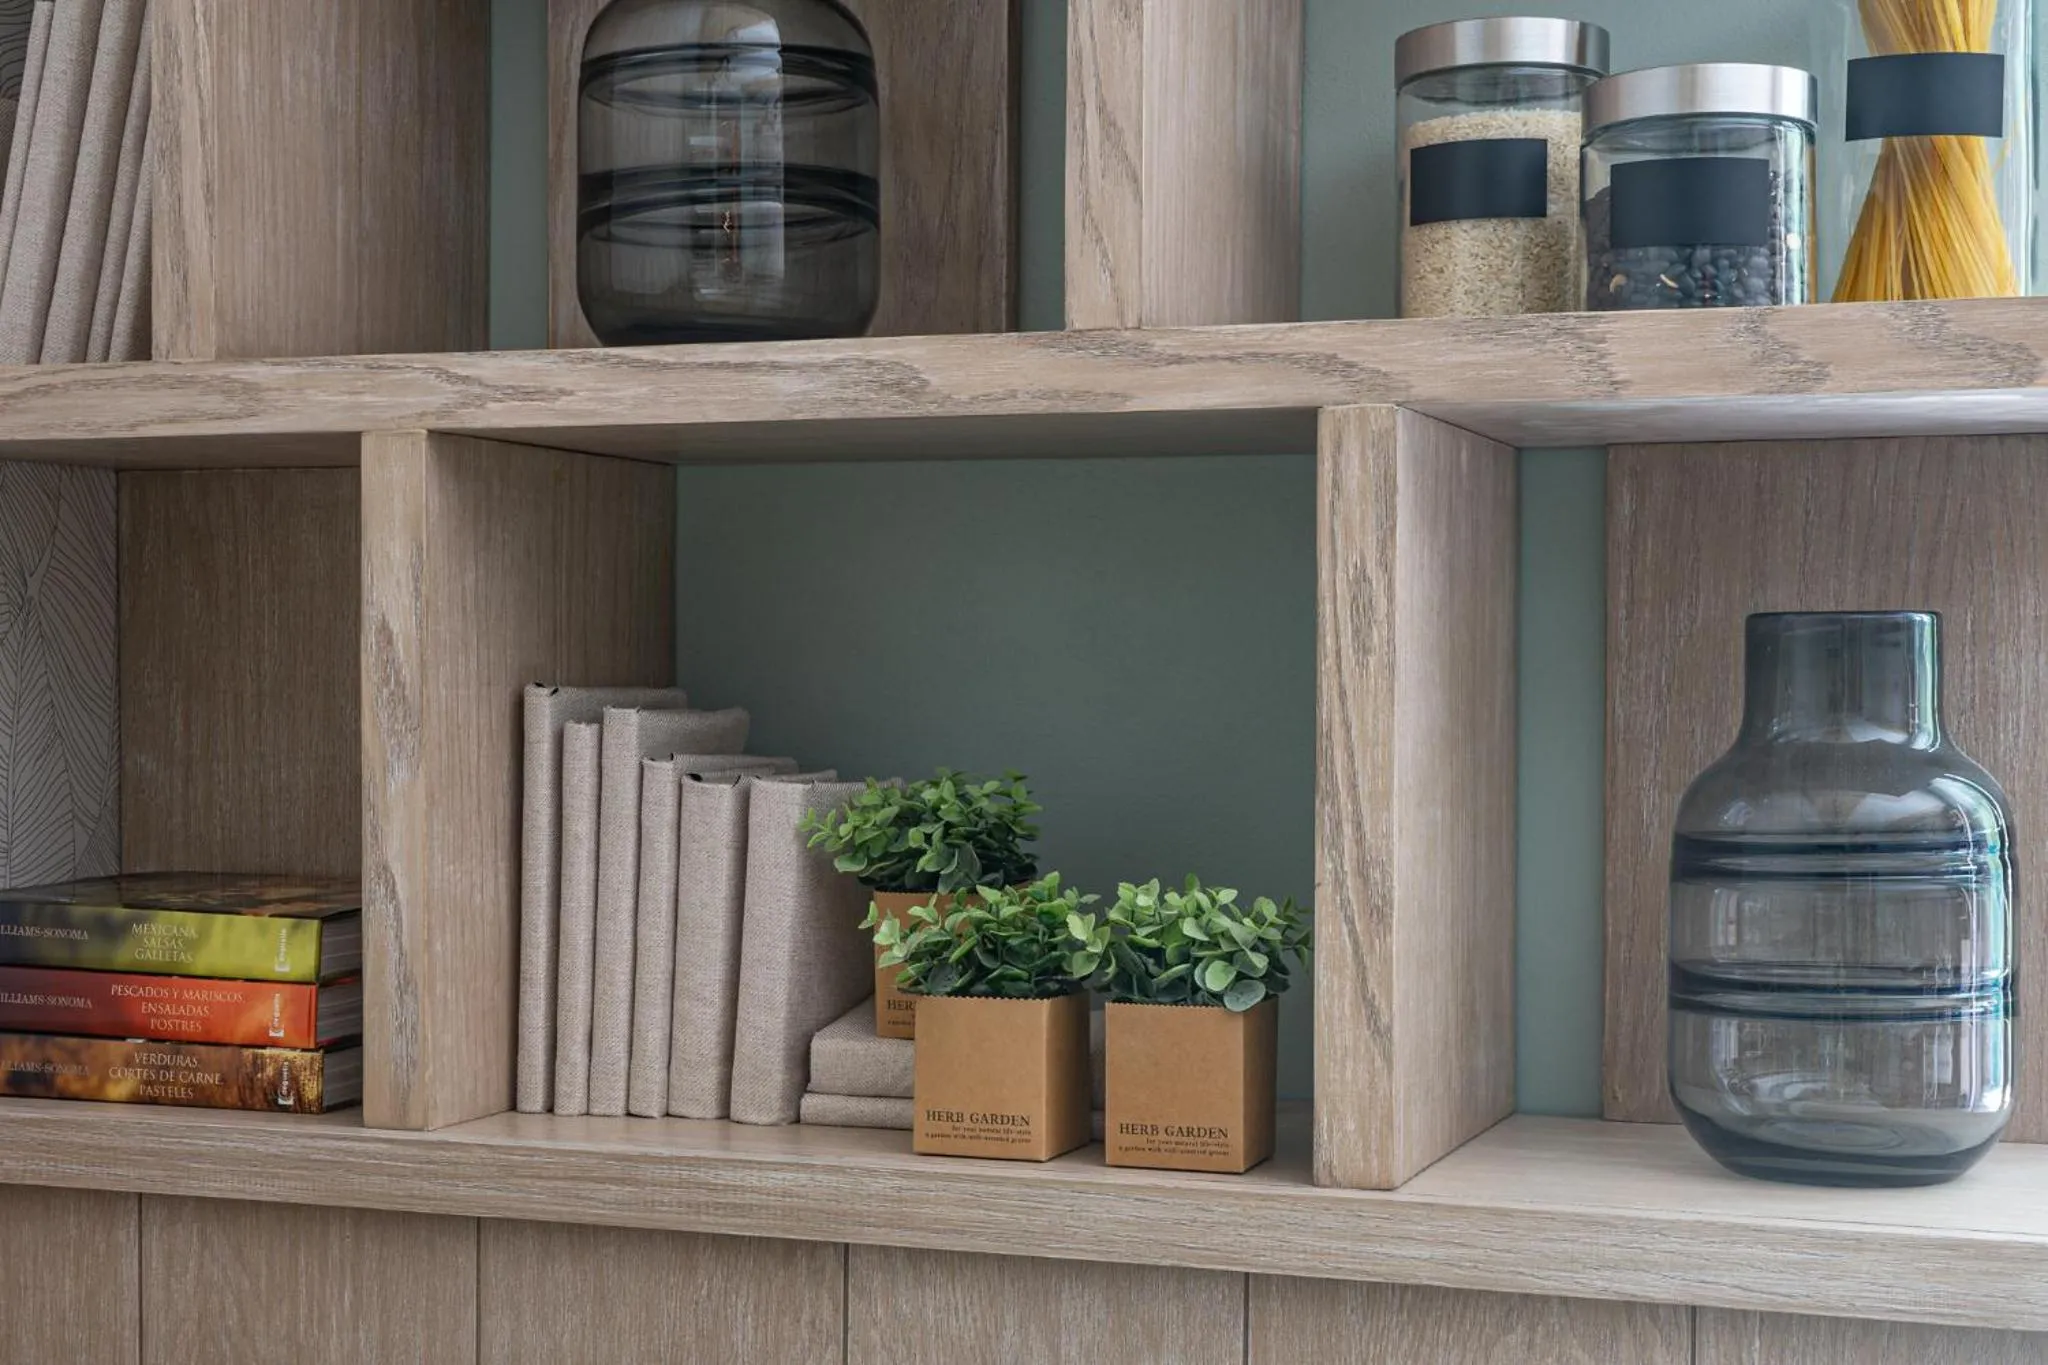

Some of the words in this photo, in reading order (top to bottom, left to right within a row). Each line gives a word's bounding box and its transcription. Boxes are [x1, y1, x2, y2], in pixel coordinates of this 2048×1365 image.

[0, 923, 89, 941] LLIAMS-SONOMA
[131, 922, 198, 939] MEXICANA
[143, 937, 185, 949] SALSAS
[134, 947, 194, 962] GALLETAS
[111, 984, 169, 999] PESCADOS
[172, 987, 178, 1000] Y
[0, 991, 93, 1010] ILLIAMS-SONOMA
[887, 999, 917, 1011] HER
[141, 1001, 210, 1017] ENSALADAS
[150, 1018, 202, 1032] POSTRES
[108, 1066, 156, 1081] CORTES
[160, 1069, 174, 1082] DE
[139, 1084, 194, 1098] PASTELES
[925, 1109, 964, 1123] HERB
[969, 1112, 1031, 1127] GARDEN
[1119, 1122, 1160, 1137] HERB
[1164, 1125, 1229, 1139] GARDEN
